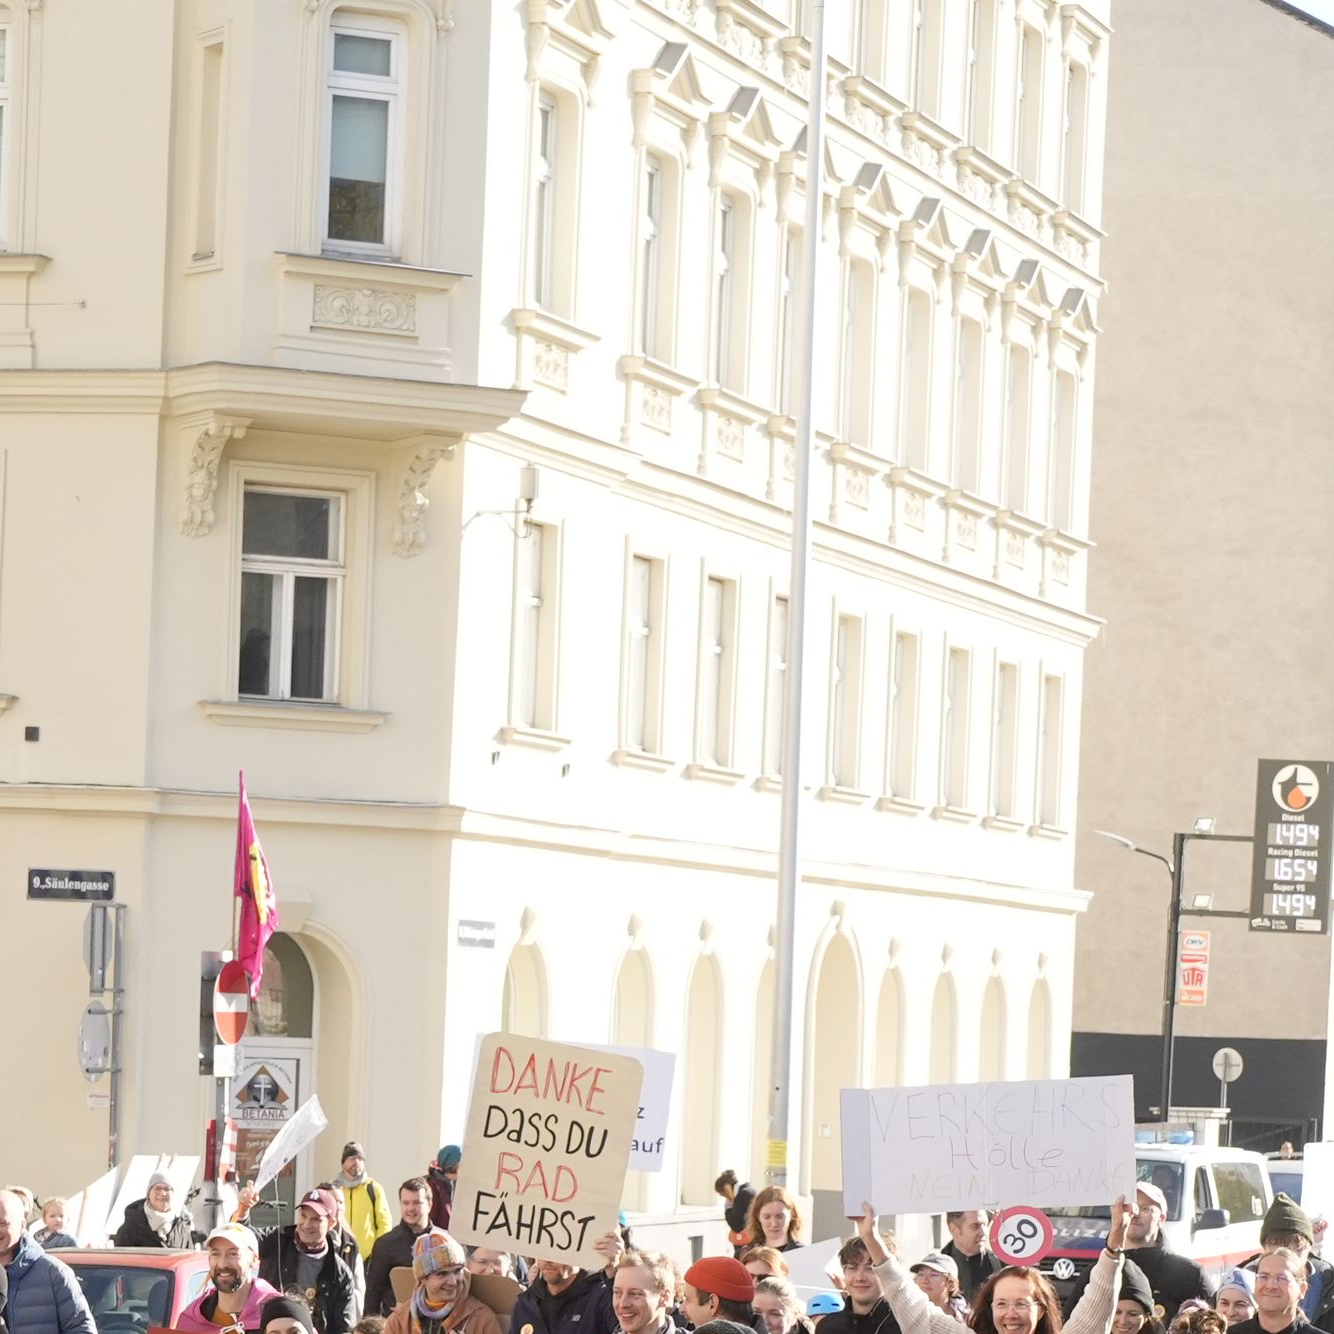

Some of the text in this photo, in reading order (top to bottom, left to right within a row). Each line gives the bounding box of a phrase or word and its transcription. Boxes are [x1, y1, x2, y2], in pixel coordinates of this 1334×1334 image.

[1281, 814, 1305, 822] Diesel
[1267, 847, 1318, 857] Racing Diesel
[490, 1047, 612, 1115] DANKE
[242, 1109, 285, 1119] BETANIA
[870, 1084, 1123, 1143] VERKEHRS
[565, 1120, 608, 1158] DU
[495, 1152, 578, 1203] RAD
[472, 1190, 595, 1252] FÄHRST
[1003, 1218, 1038, 1254] 30
